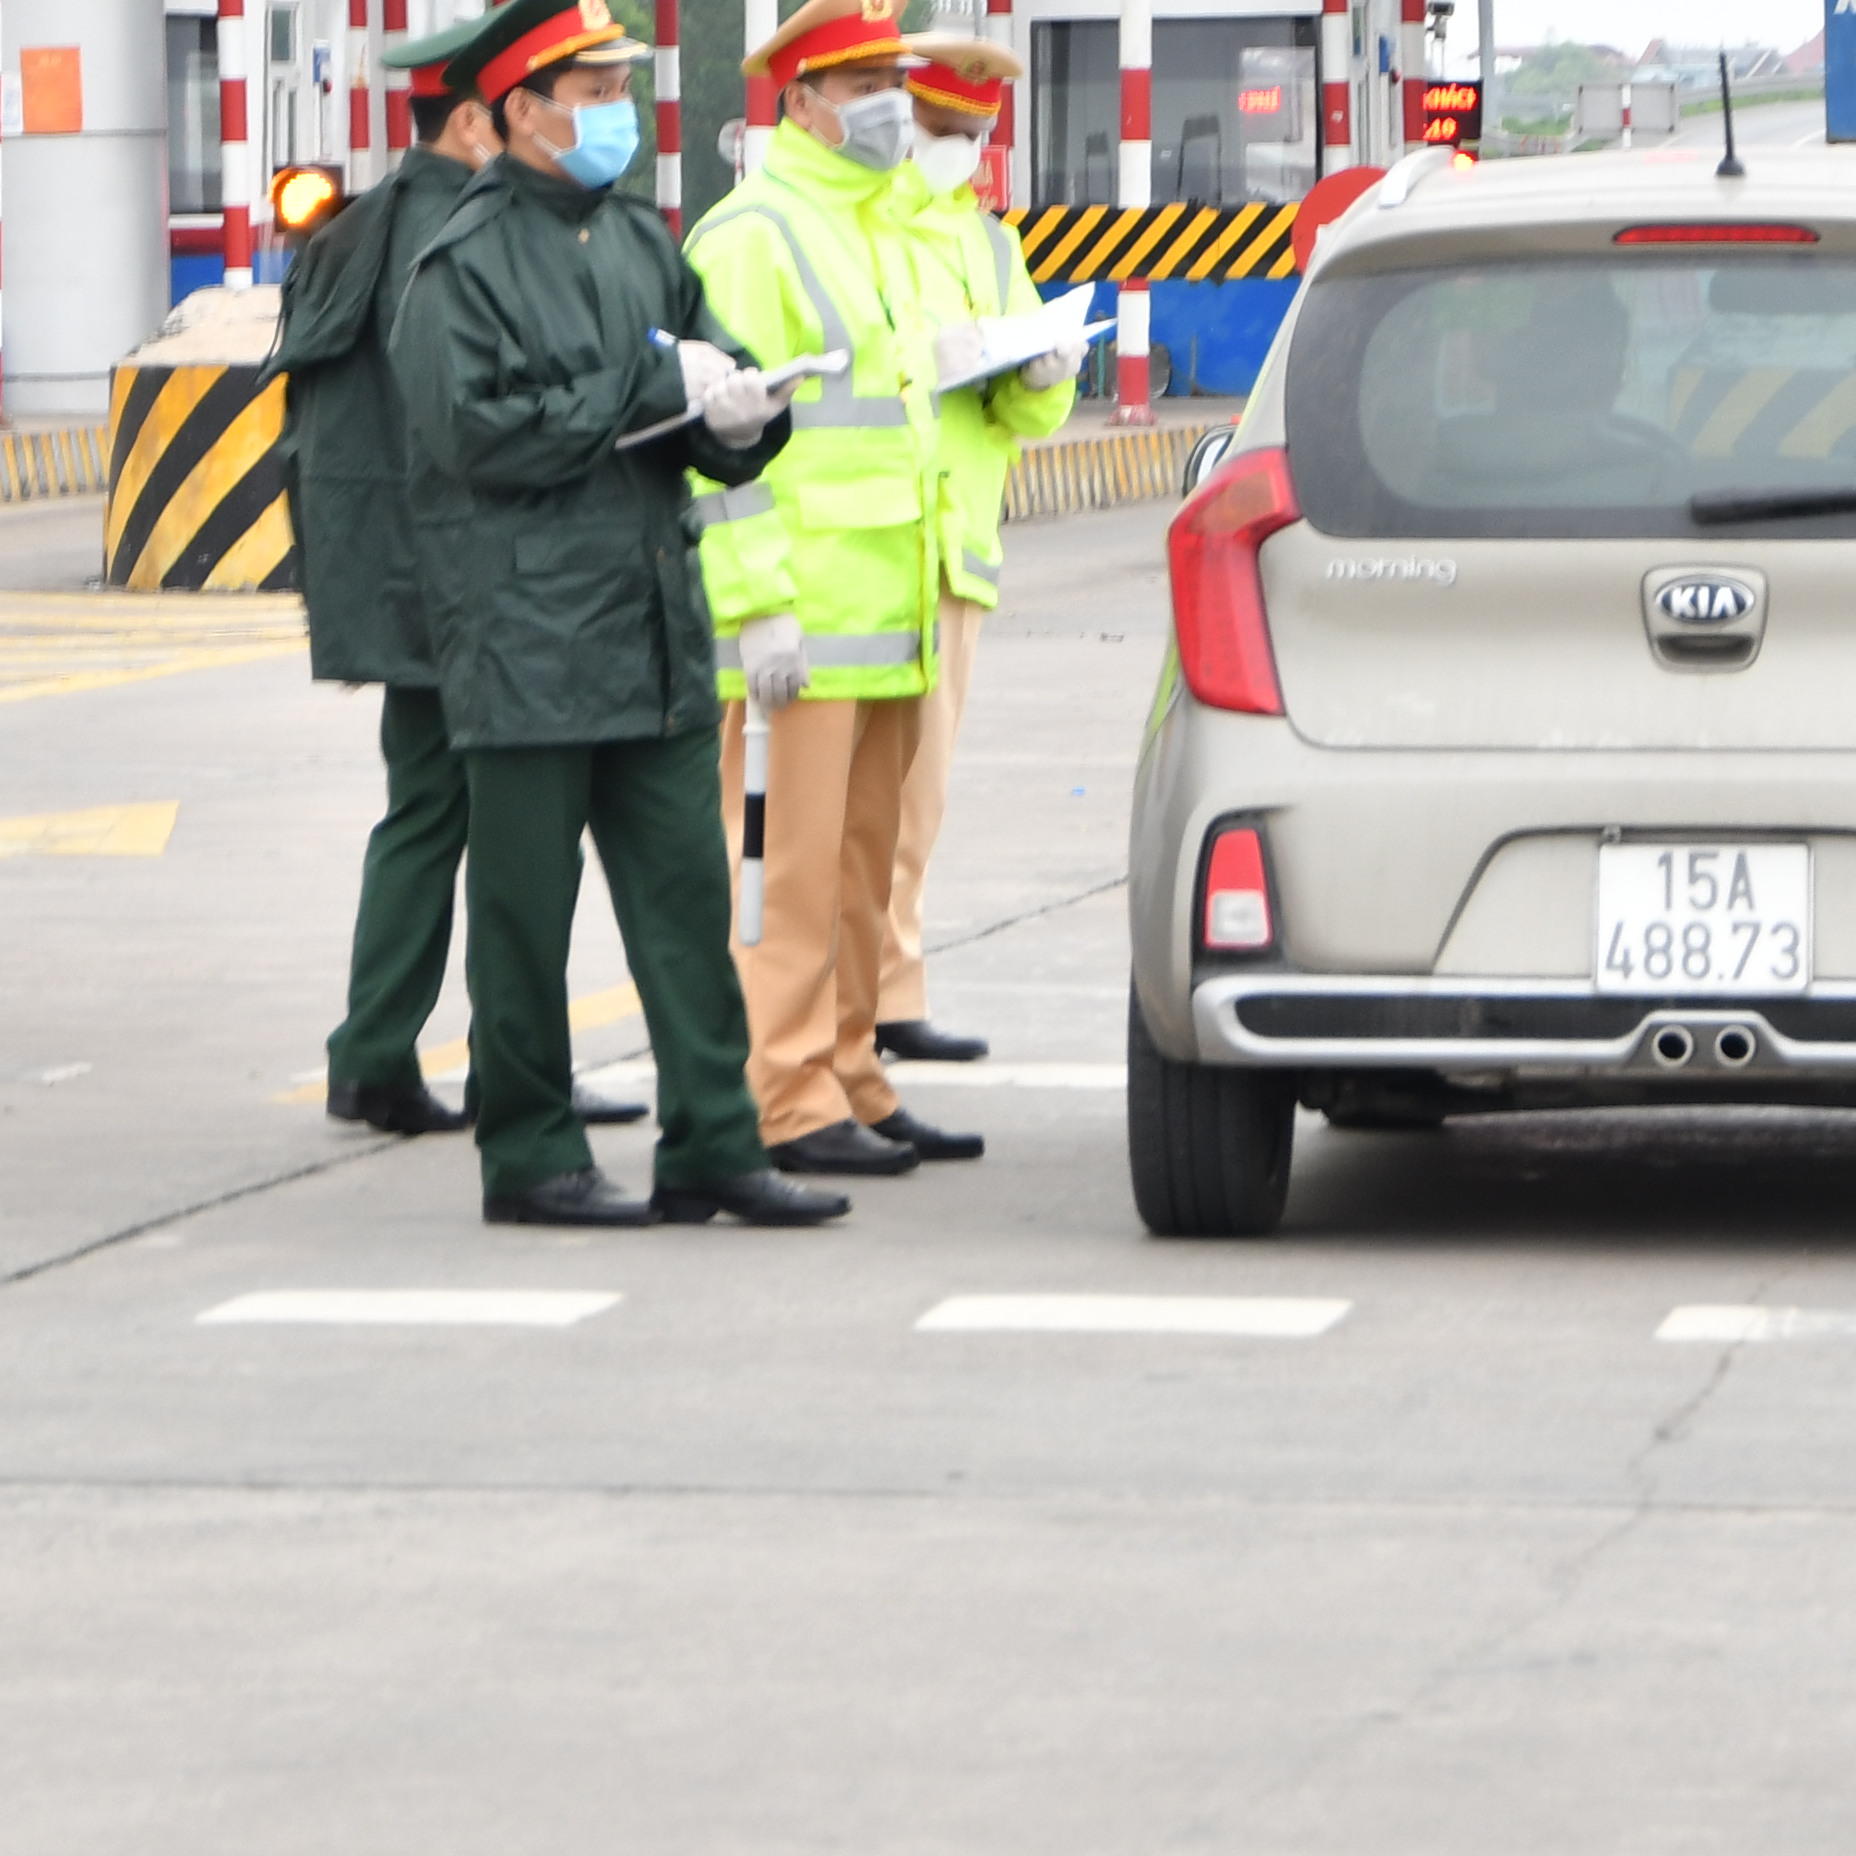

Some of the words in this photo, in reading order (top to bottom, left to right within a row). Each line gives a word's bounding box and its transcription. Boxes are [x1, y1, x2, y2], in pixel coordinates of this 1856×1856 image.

[1327, 554, 1457, 586] morning
[1671, 585, 1738, 618] KIA
[1657, 851, 1755, 912] 15A
[1606, 920, 1800, 981] 488.73
